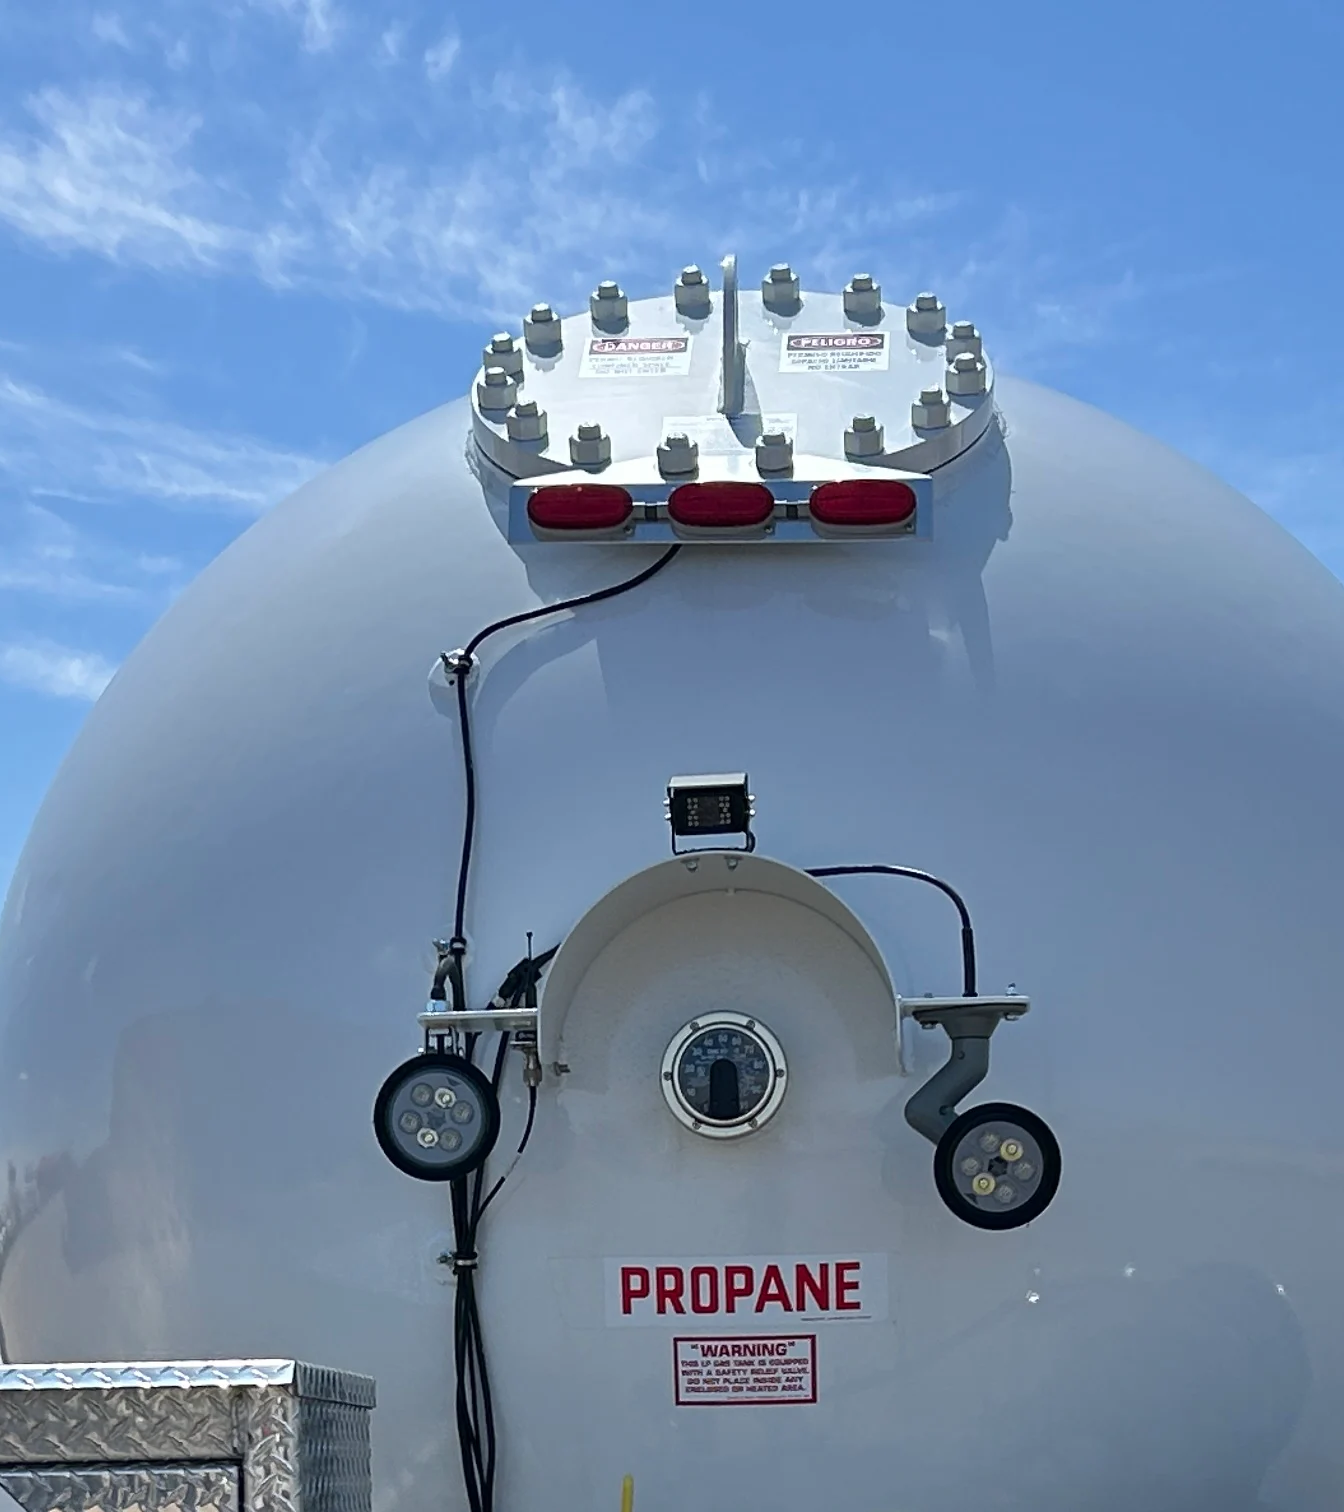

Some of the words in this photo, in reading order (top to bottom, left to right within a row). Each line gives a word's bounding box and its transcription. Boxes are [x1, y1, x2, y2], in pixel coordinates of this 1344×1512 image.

[801, 337, 871, 347] PELIGRO
[621, 1261, 861, 1315] PROPANE
[715, 1368, 748, 1376] SAFETY
